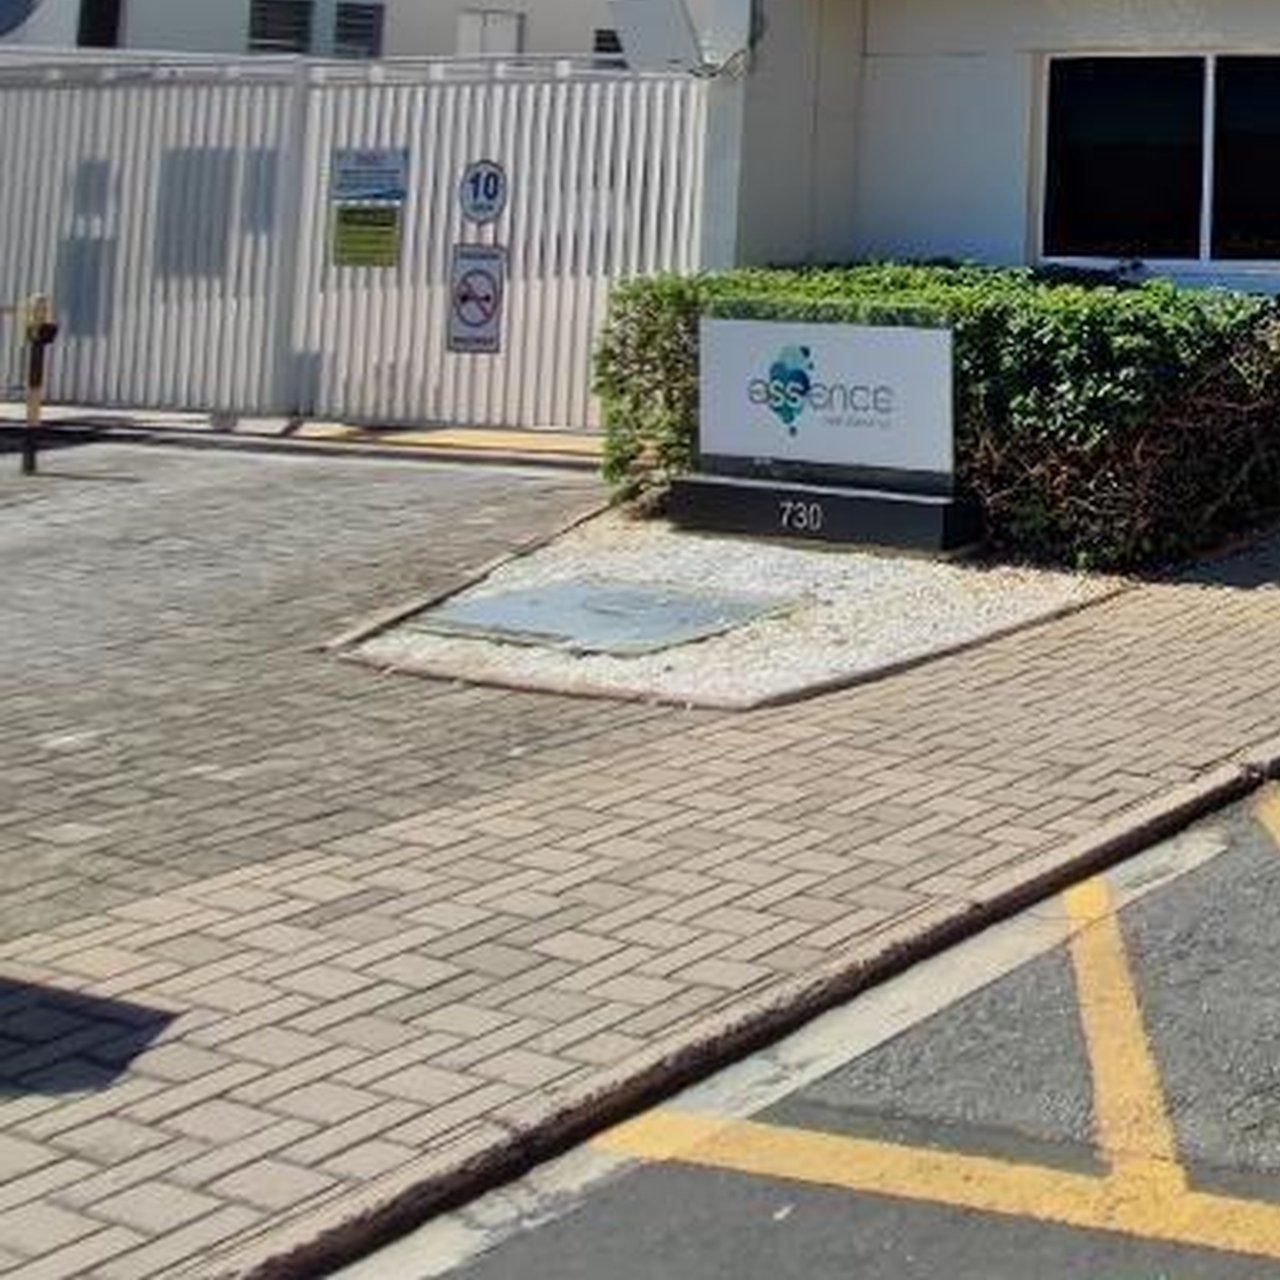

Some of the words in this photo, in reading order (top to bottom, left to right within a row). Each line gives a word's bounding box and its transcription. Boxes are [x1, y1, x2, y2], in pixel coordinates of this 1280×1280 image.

[469, 172, 499, 200] 10
[748, 379, 895, 414] essence
[779, 502, 822, 530] 730
